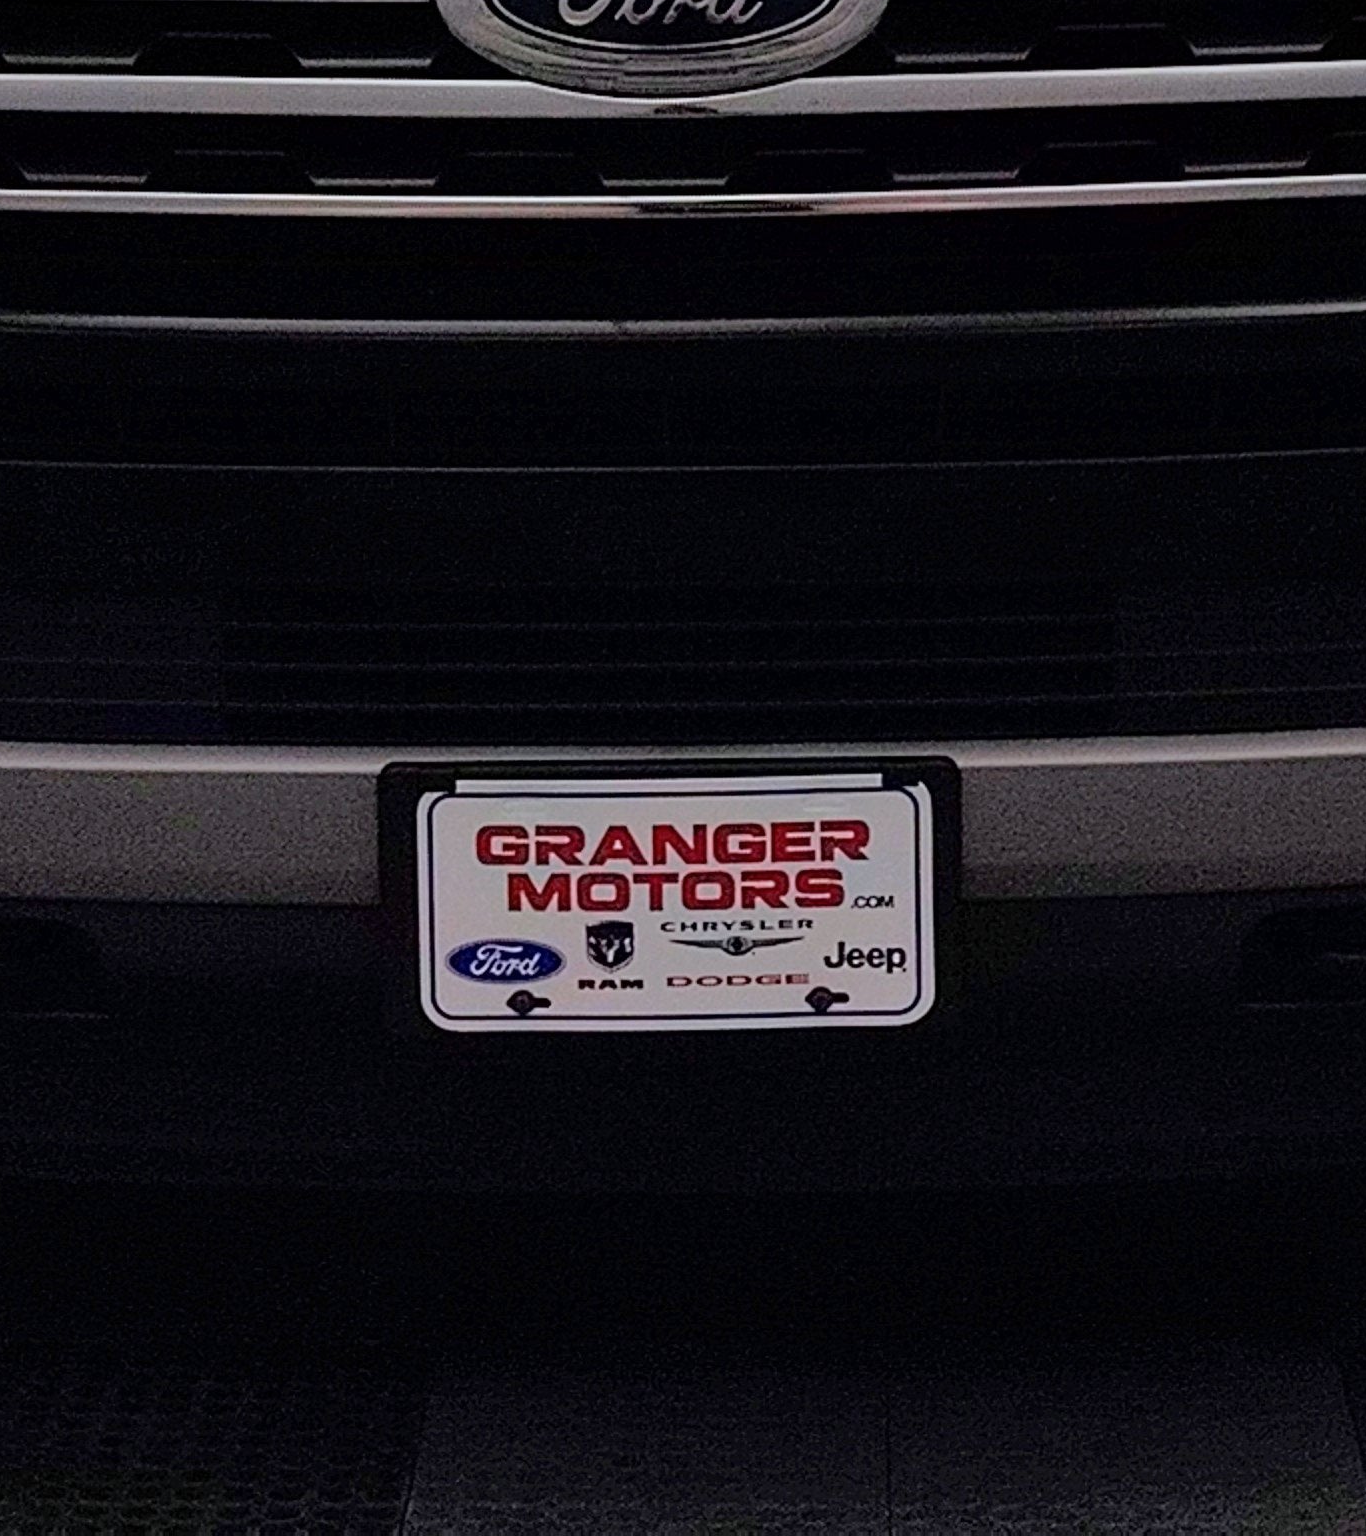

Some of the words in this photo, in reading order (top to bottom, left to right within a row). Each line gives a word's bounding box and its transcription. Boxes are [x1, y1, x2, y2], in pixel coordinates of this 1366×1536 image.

[475, 819, 871, 867] GRANGER
[506, 868, 846, 912] MOTORS
[660, 919, 814, 932] CHRYSLER
[469, 943, 542, 976] Ford
[823, 941, 907, 974] Jeep
[578, 979, 644, 989] RAM
[666, 974, 810, 987] DODGE
